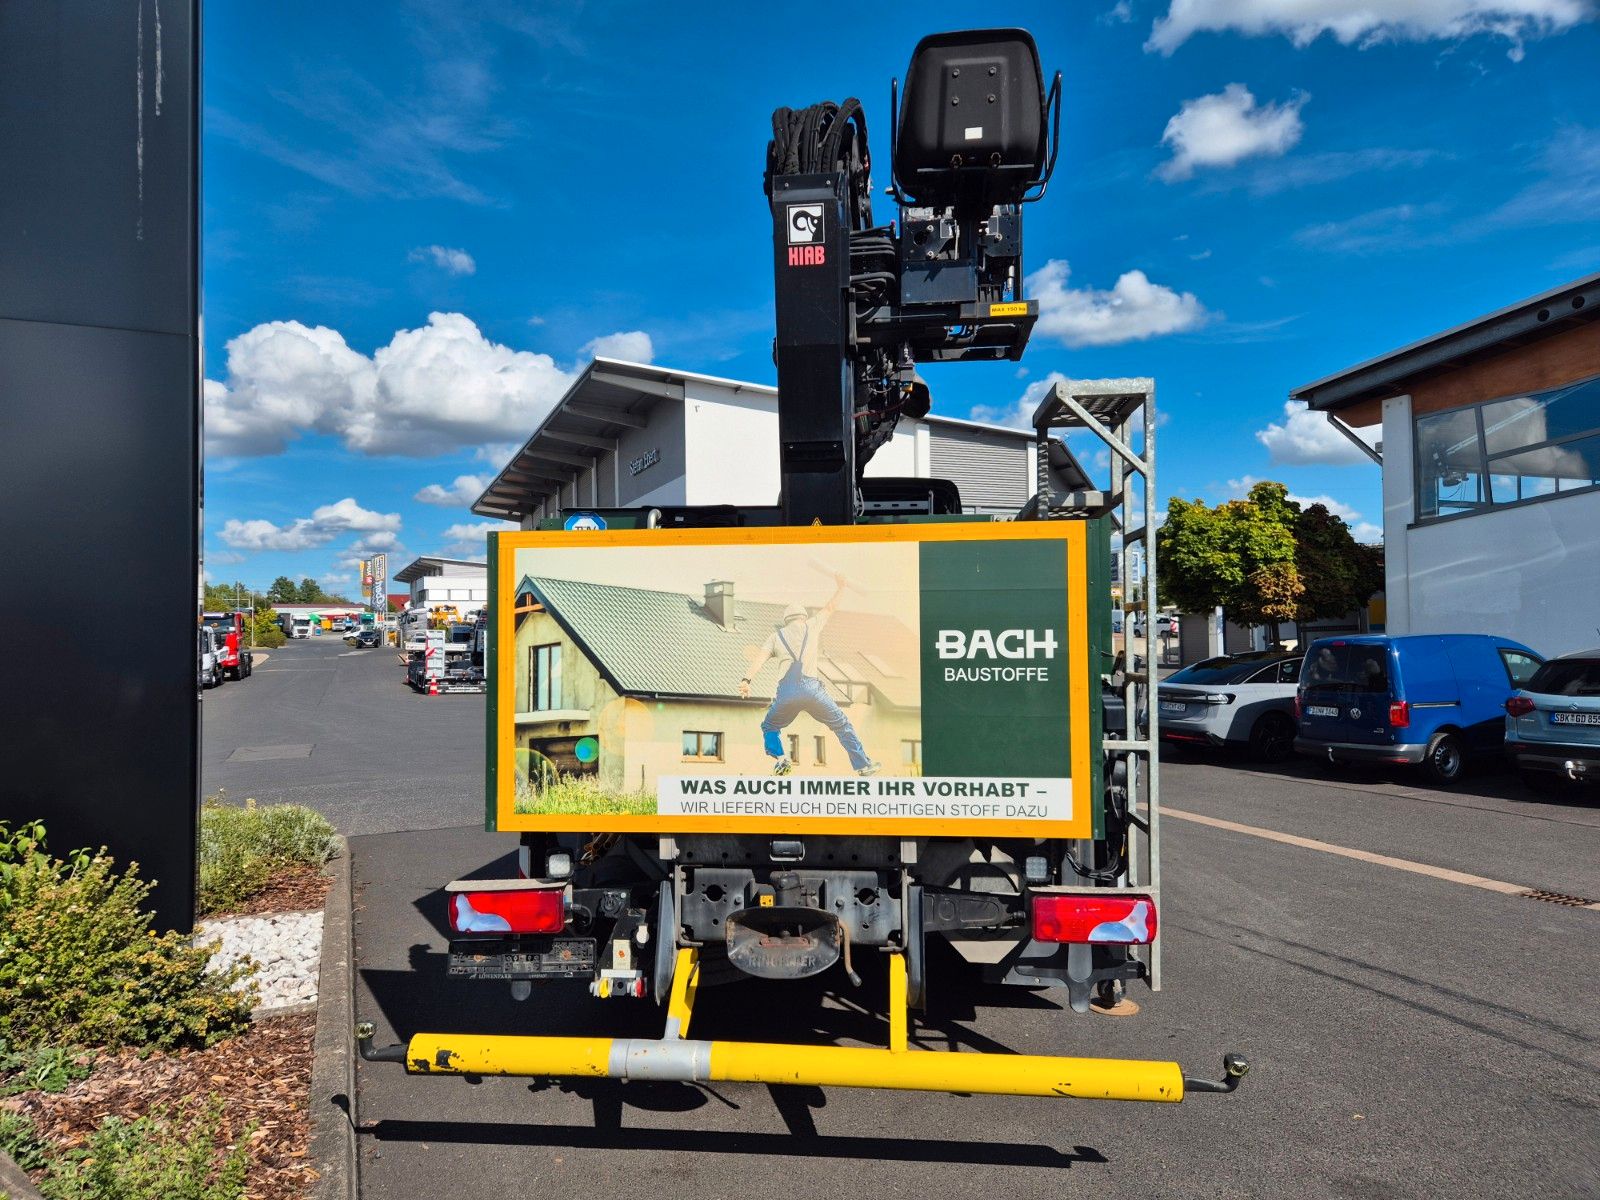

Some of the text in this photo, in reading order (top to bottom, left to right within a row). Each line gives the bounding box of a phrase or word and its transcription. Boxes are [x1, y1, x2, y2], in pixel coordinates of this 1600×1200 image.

[788, 245, 825, 266] HIAB
[935, 629, 1059, 659] BACH
[944, 667, 1049, 682] BAUSTOFFE
[1555, 713, 1571, 723] SBK
[1575, 714, 1587, 723] GD
[680, 780, 727, 795] WAS
[733, 780, 792, 795] AUCH
[800, 781, 871, 796] IMMER
[878, 781, 915, 796] IHR
[922, 782, 1030, 798] VORHABT
[680, 801, 1049, 817] WIR LIEFERN EUCH DEN RICHTIGEN STOFF DAZU
